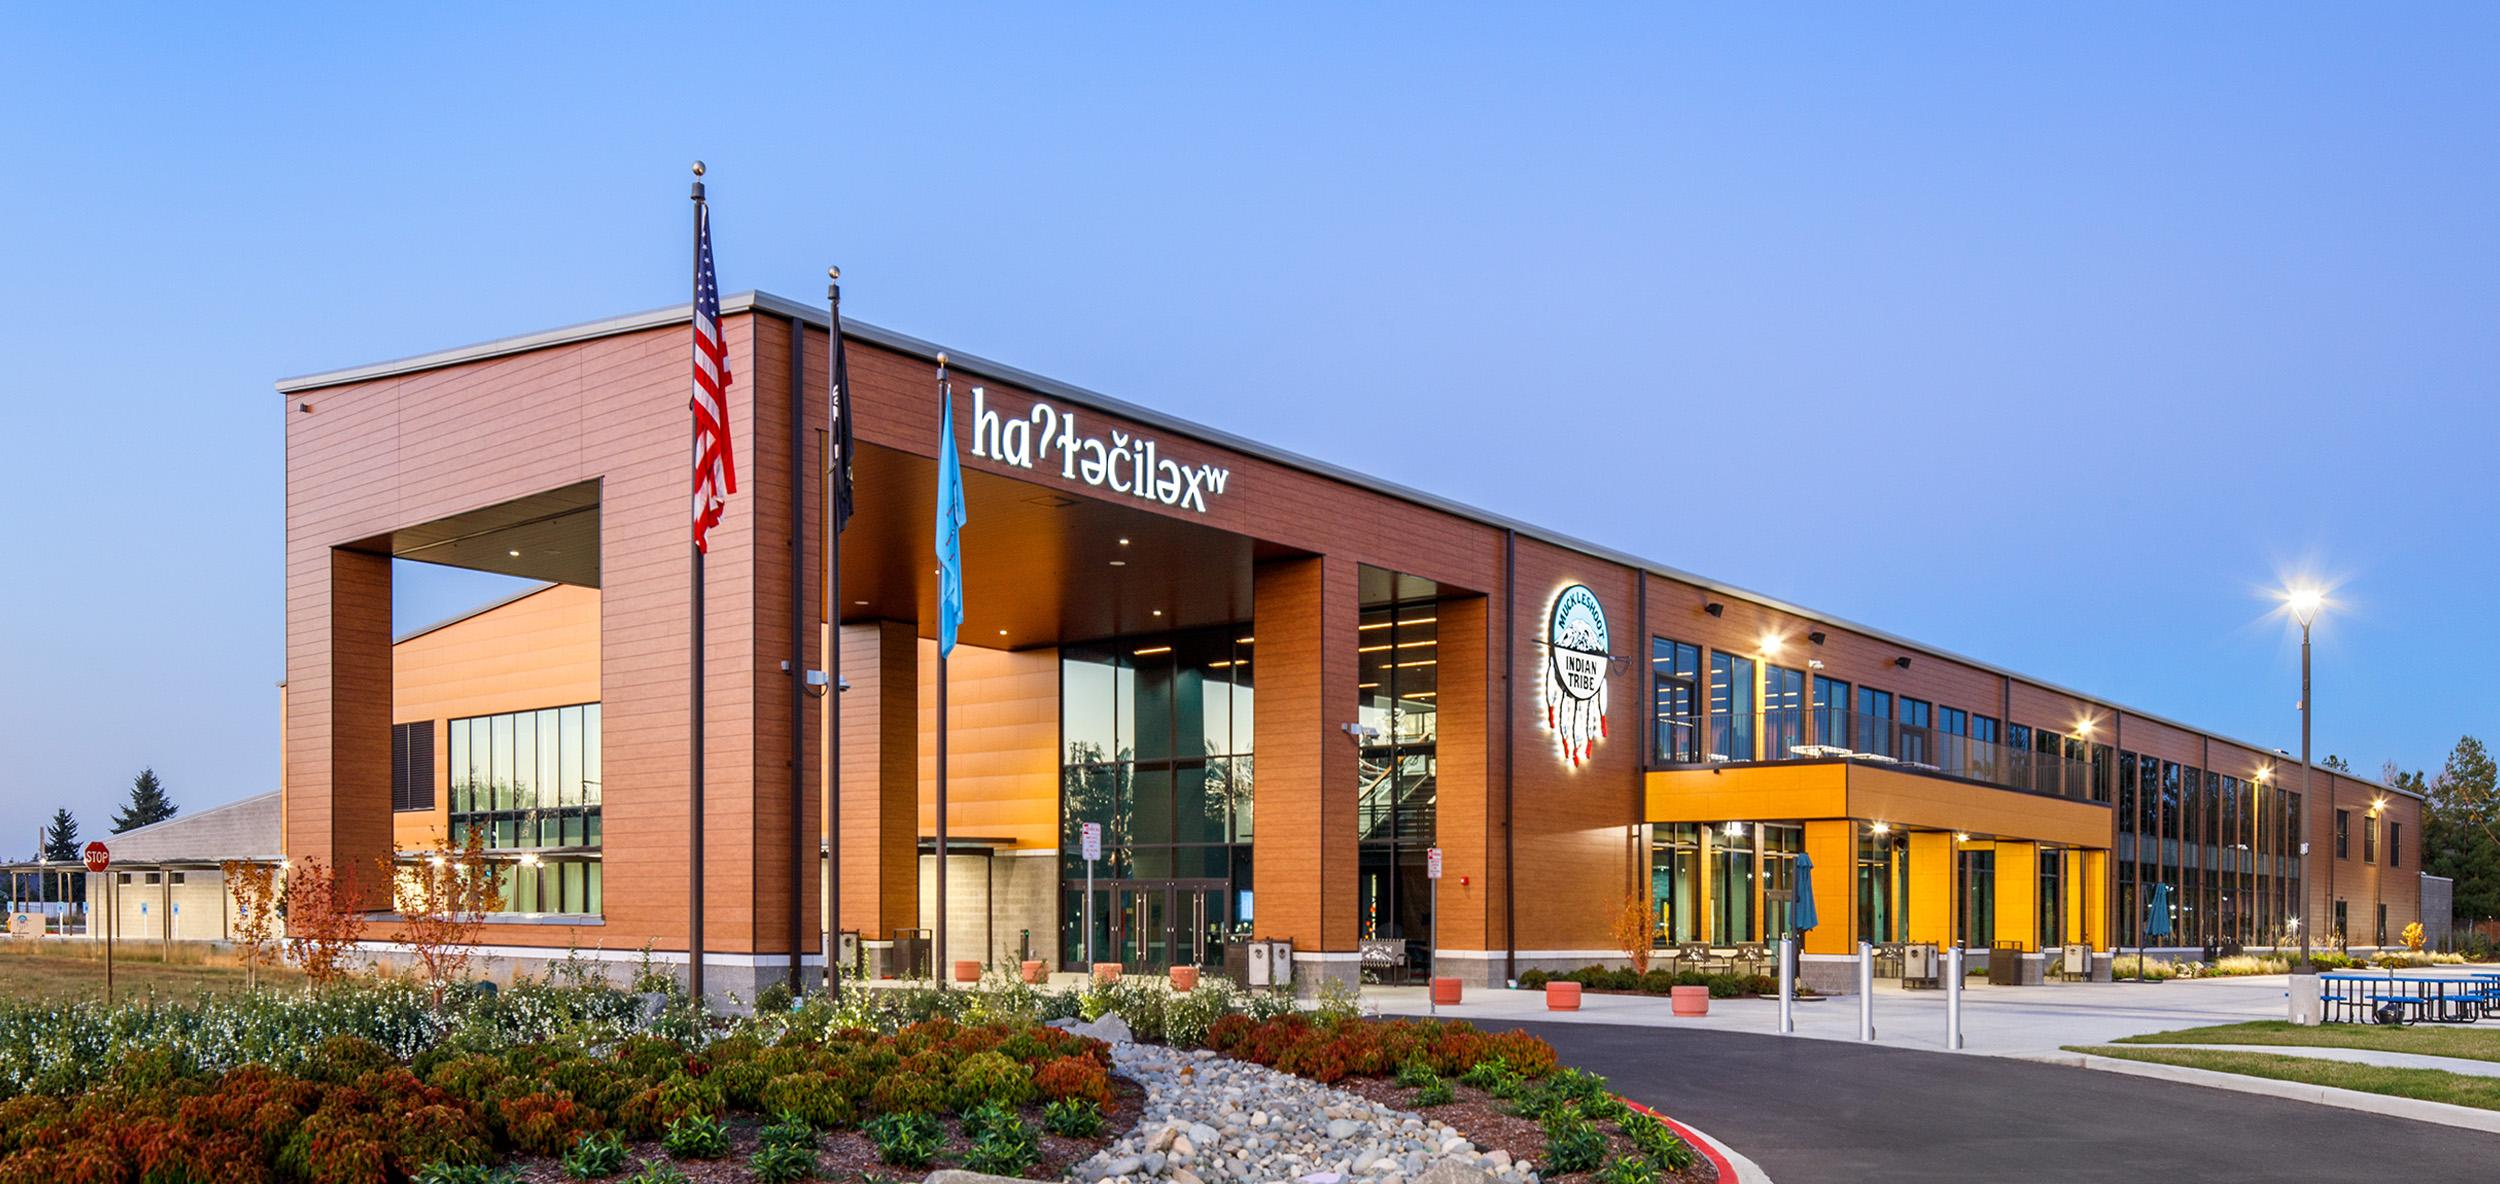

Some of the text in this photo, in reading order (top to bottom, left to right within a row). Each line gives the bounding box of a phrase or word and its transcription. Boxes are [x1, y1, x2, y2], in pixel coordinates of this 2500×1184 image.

[1558, 592, 1605, 640] MUCKLESHOOT
[1566, 655, 1597, 675] INDIAN
[1567, 672, 1595, 691] TRIBE
[86, 851, 108, 863] STOP
